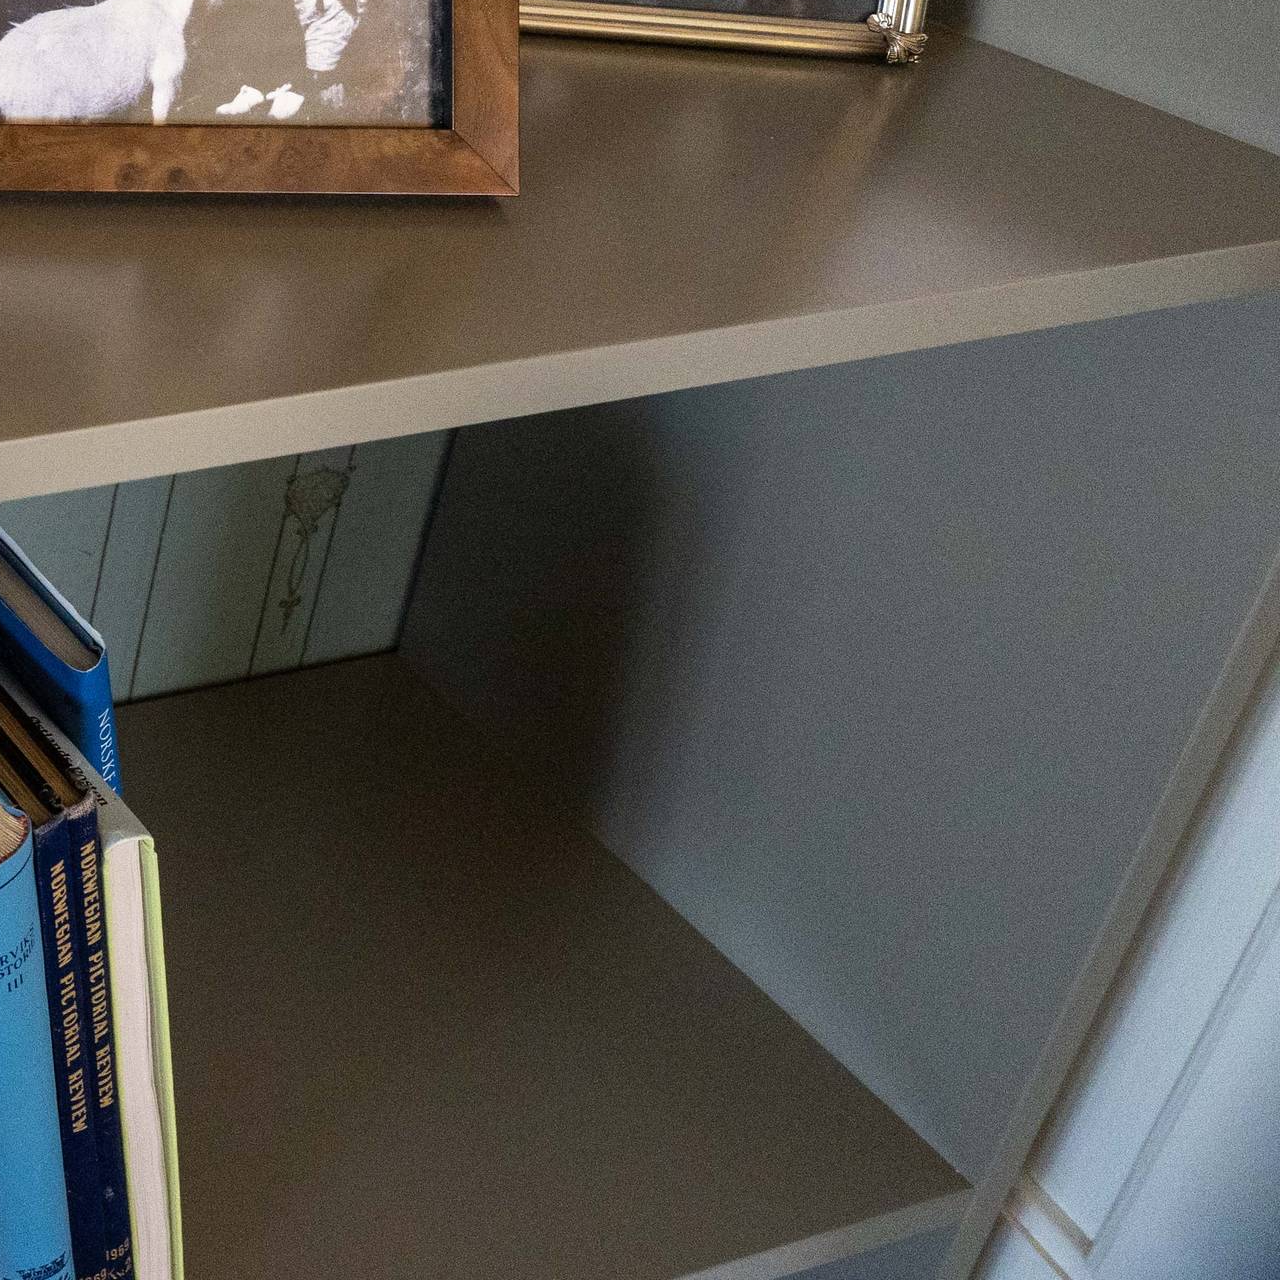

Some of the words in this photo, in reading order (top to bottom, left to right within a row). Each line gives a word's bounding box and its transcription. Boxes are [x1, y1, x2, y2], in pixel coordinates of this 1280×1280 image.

[49, 858, 74, 968] NORWEGIAN
[80, 839, 102, 946] NORWEGIAN
[7, 973, 24, 993] III
[59, 970, 81, 1067] PICTORIAL
[87, 949, 109, 1044] PICTORIAL
[67, 1067, 88, 1134] REVIEW
[94, 1043, 113, 1109] REVIEW
